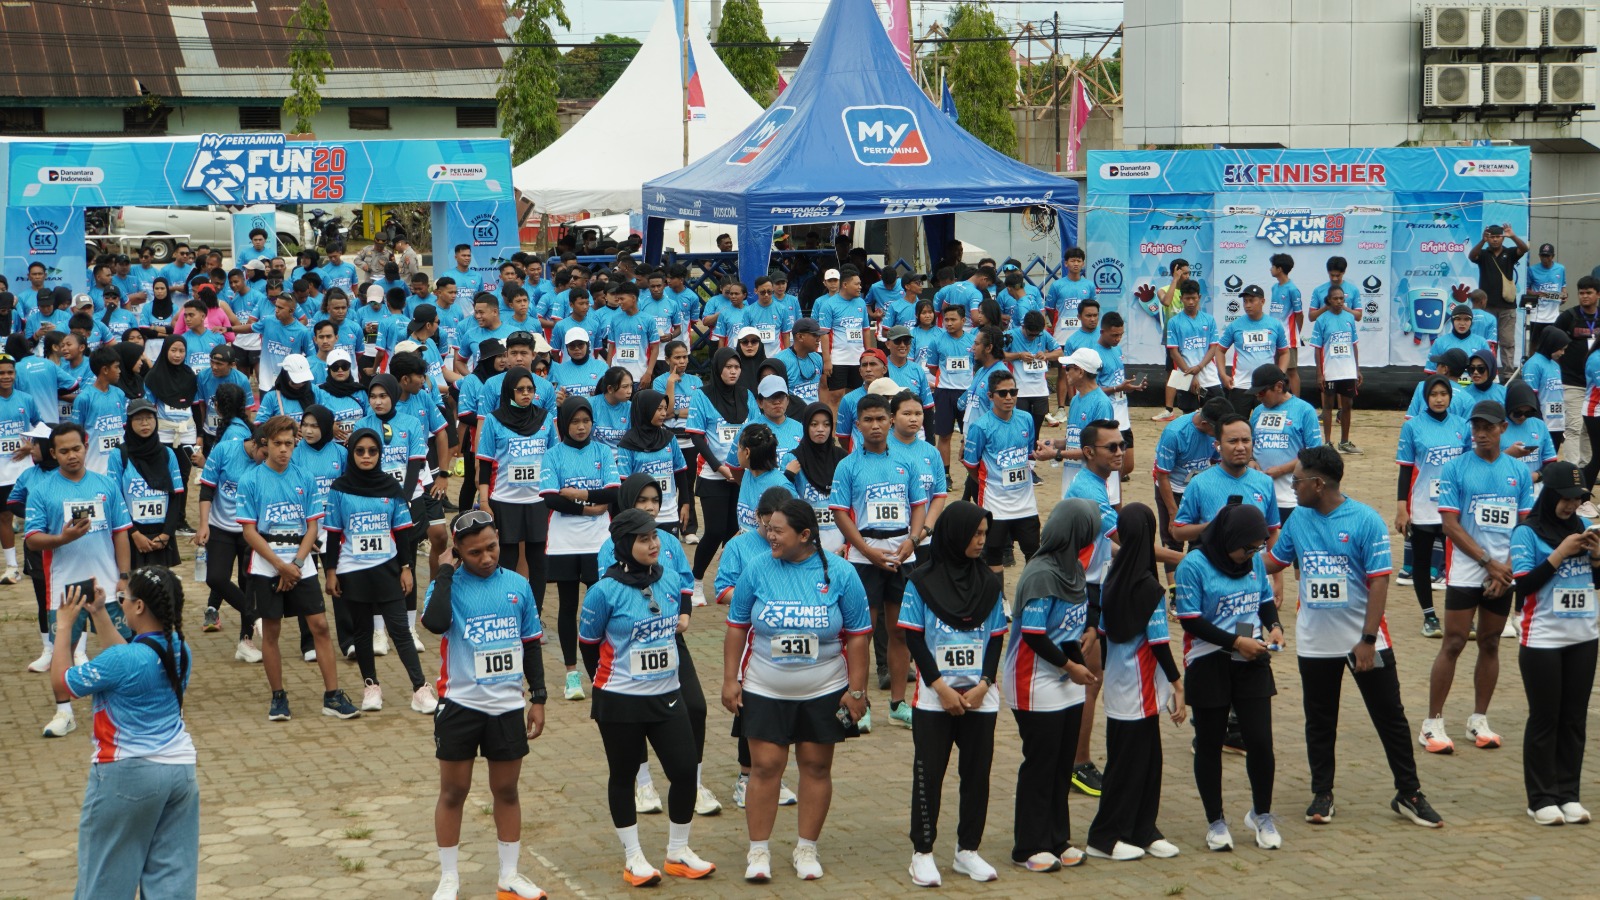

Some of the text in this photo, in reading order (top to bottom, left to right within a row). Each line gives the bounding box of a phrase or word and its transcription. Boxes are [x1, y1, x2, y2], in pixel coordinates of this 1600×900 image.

[858, 120, 909, 146] My
[863, 146, 920, 155] PERTAMINA
[770, 206, 830, 214] PERTAMAX
[884, 203, 940, 214] DEX
[470, 213, 500, 224] FINISHER
[26, 220, 59, 231] FINISHER
[1140, 243, 1182, 255] Bright Gas
[1421, 241, 1464, 254] Bright Gas
[1091, 257, 1125, 269] FINISHER
[951, 360, 965, 369] 241
[1027, 361, 1043, 369] 720
[1261, 416, 1281, 426] 836
[2, 441, 20, 451] 284
[514, 468, 535, 480] 212
[1009, 469, 1026, 482] 841
[139, 504, 162, 516] 748
[876, 506, 899, 519] 186
[1482, 509, 1509, 524] 595
[360, 538, 383, 551] 341
[1311, 583, 1340, 598] 849
[1561, 593, 1585, 608] 419
[782, 639, 811, 655] 331
[486, 655, 513, 673] 109
[640, 652, 668, 671] 108
[944, 650, 974, 666] 468
